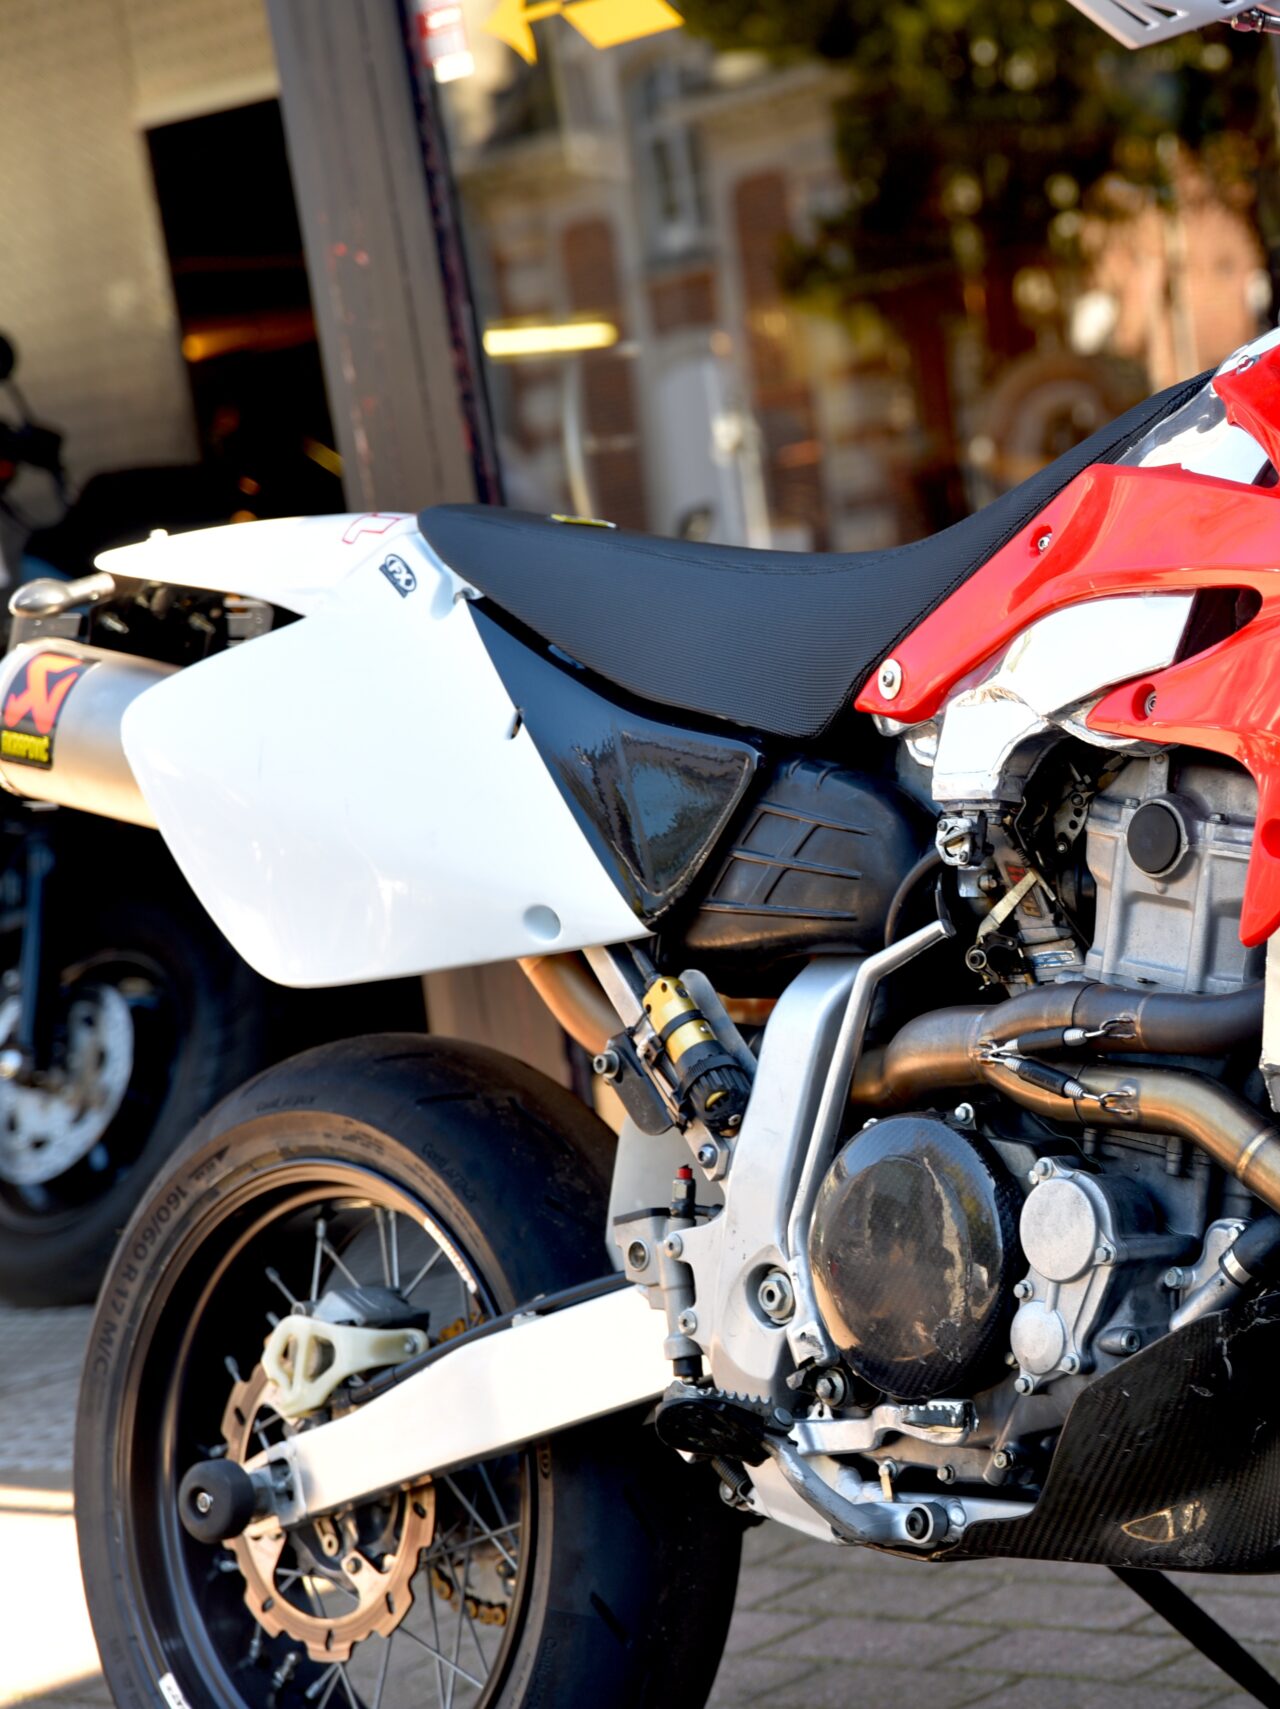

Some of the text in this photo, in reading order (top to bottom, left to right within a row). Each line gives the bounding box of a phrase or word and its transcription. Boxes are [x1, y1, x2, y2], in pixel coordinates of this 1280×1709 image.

[92, 1185, 188, 1371] 160/60 R 17 M/C
